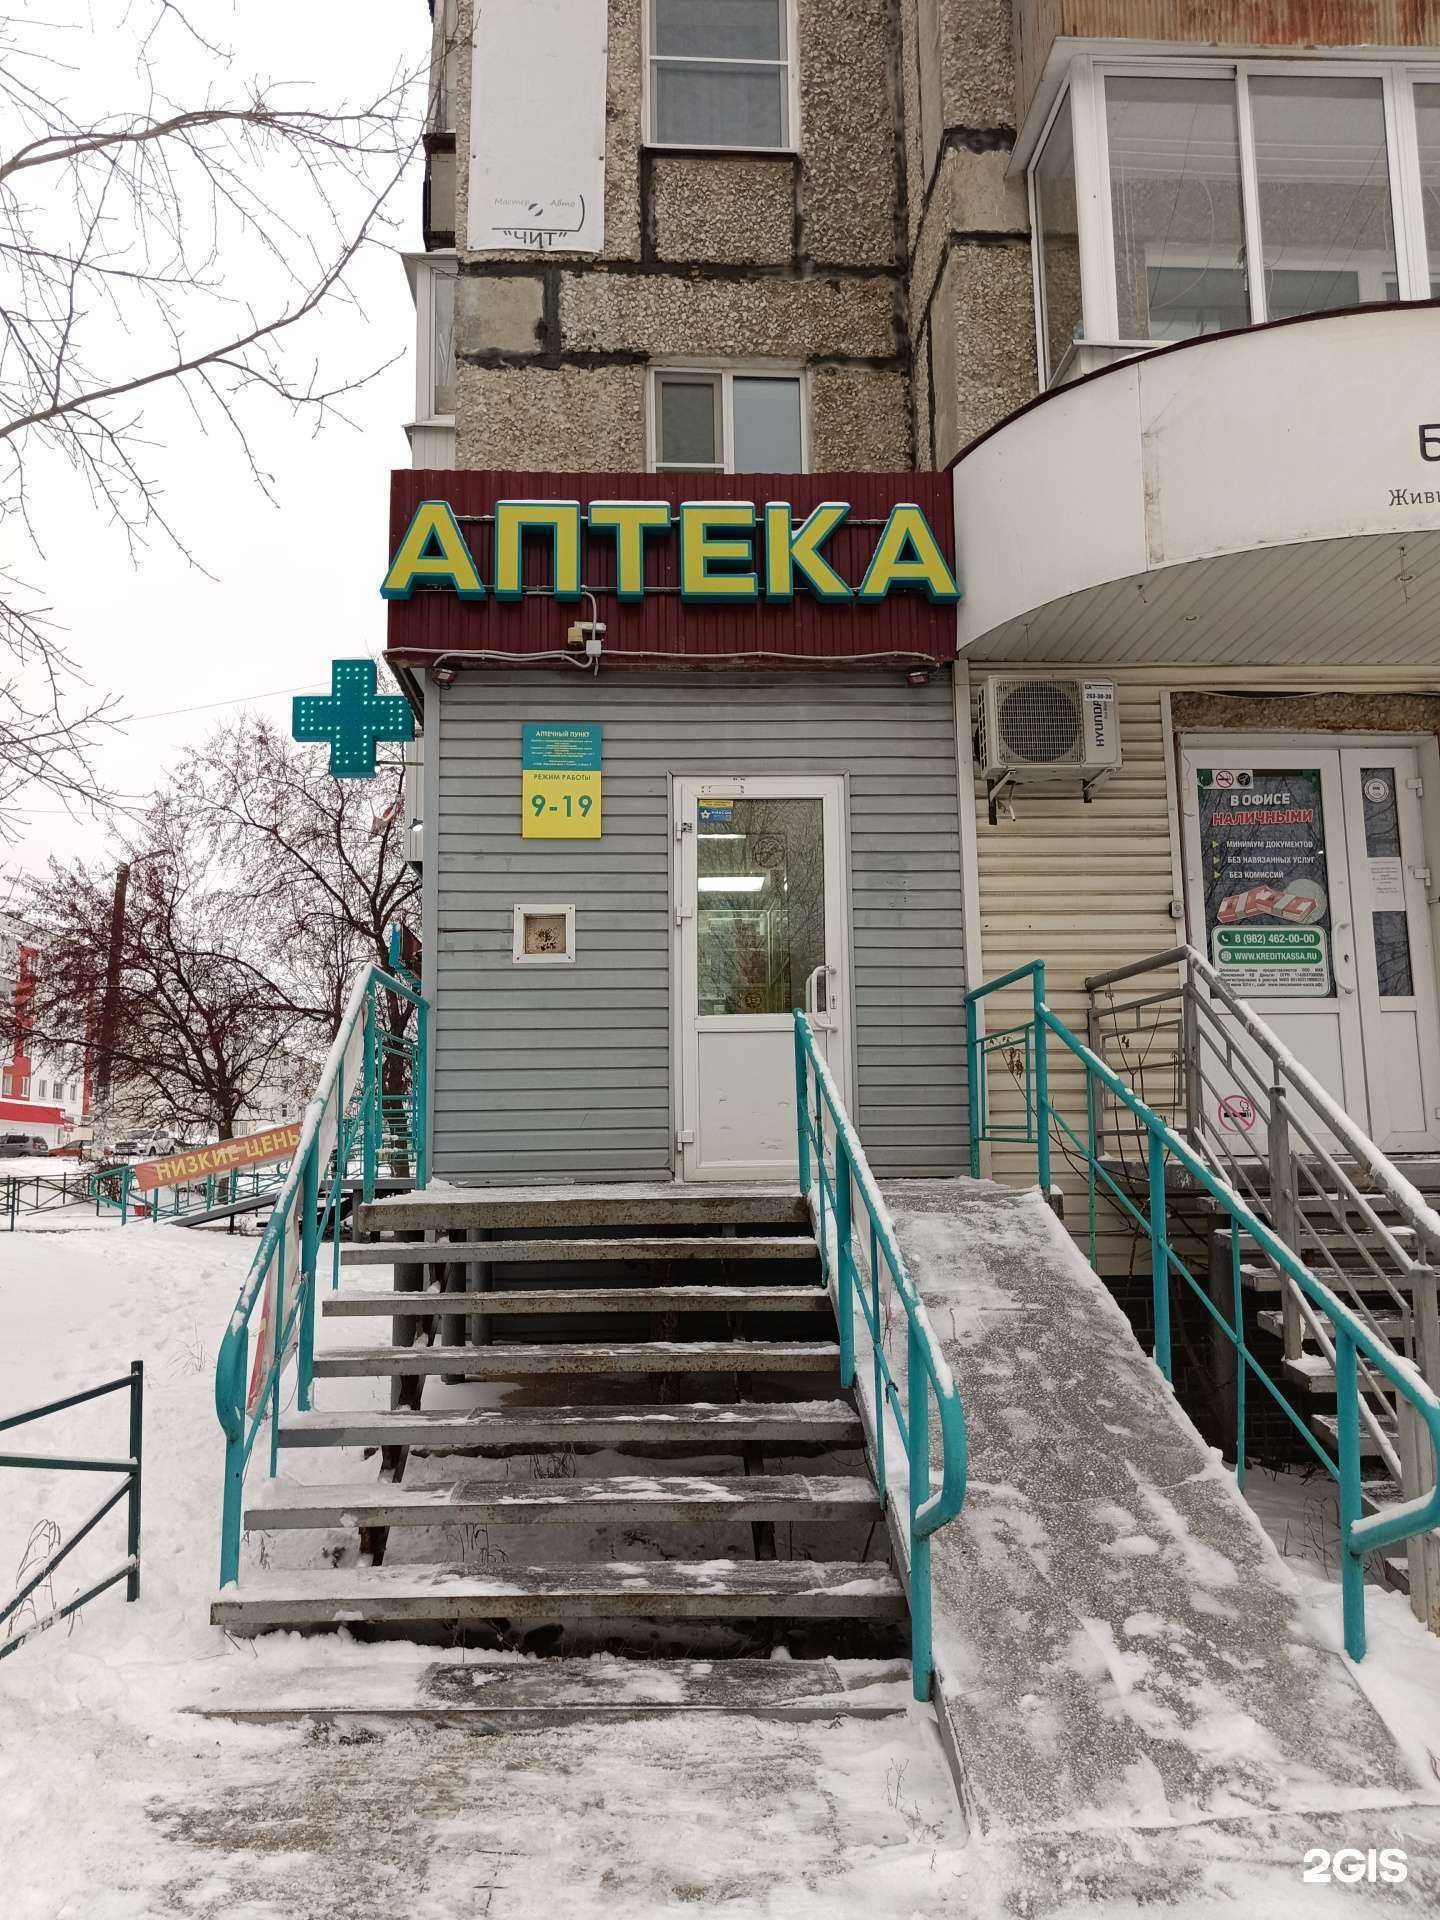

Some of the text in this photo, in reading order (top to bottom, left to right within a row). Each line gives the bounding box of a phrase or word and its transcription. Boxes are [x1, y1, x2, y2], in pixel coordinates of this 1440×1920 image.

[381, 500, 961, 603] АПТЕКА
[1093, 700, 1105, 747] HYUNDA
[531, 794, 593, 818] 9-19
[1230, 793, 1291, 807] В ОФИСЕ
[1212, 809, 1314, 826] НАЛИЧНЫМИ
[1226, 840, 1314, 849] МИНИМУМ ДОКУМЕНТОВ
[1227, 856, 1315, 864] БЕЗ НАВЯЗАННЫХ УСЛУГ
[1229, 871, 1243, 879] БЕЗ
[154, 1143, 240, 1181] НИЗКИЕ
